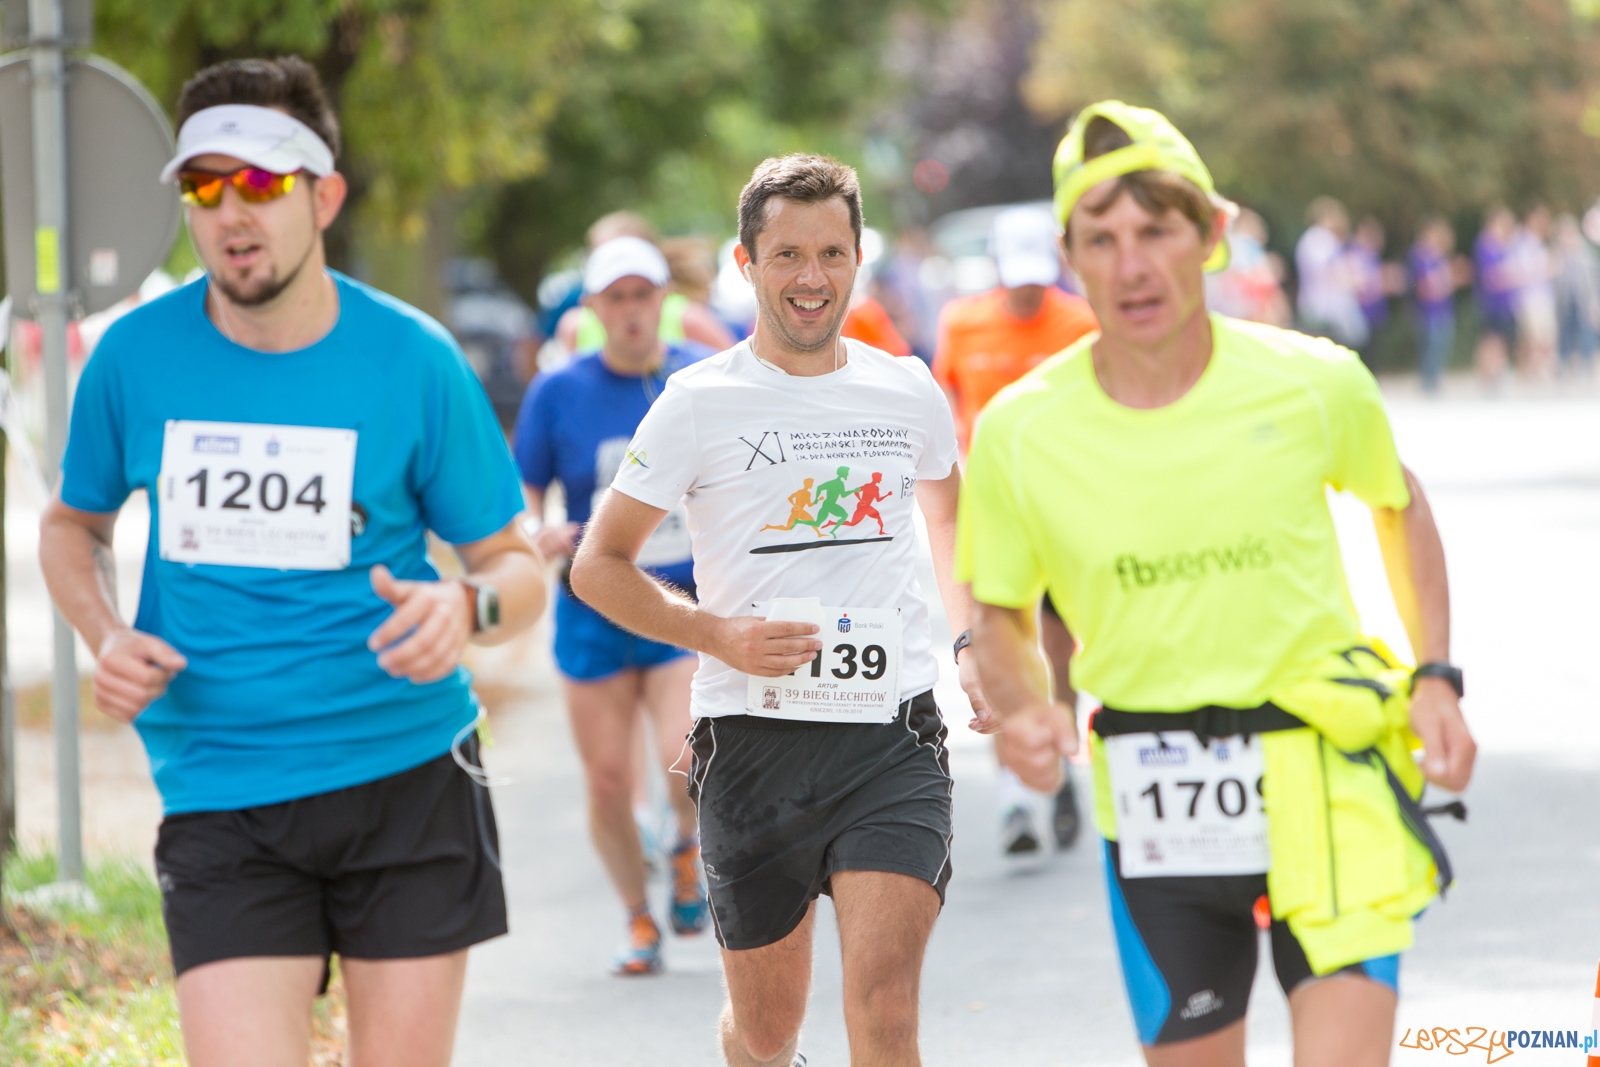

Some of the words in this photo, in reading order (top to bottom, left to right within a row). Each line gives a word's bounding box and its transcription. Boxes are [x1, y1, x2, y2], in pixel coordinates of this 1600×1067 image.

[738, 431, 787, 471] XI
[187, 468, 327, 514] 1204
[786, 643, 887, 680] 139
[785, 689, 799, 699] 39
[803, 690, 830, 700] BIEG
[833, 691, 887, 702] LECHITÓW
